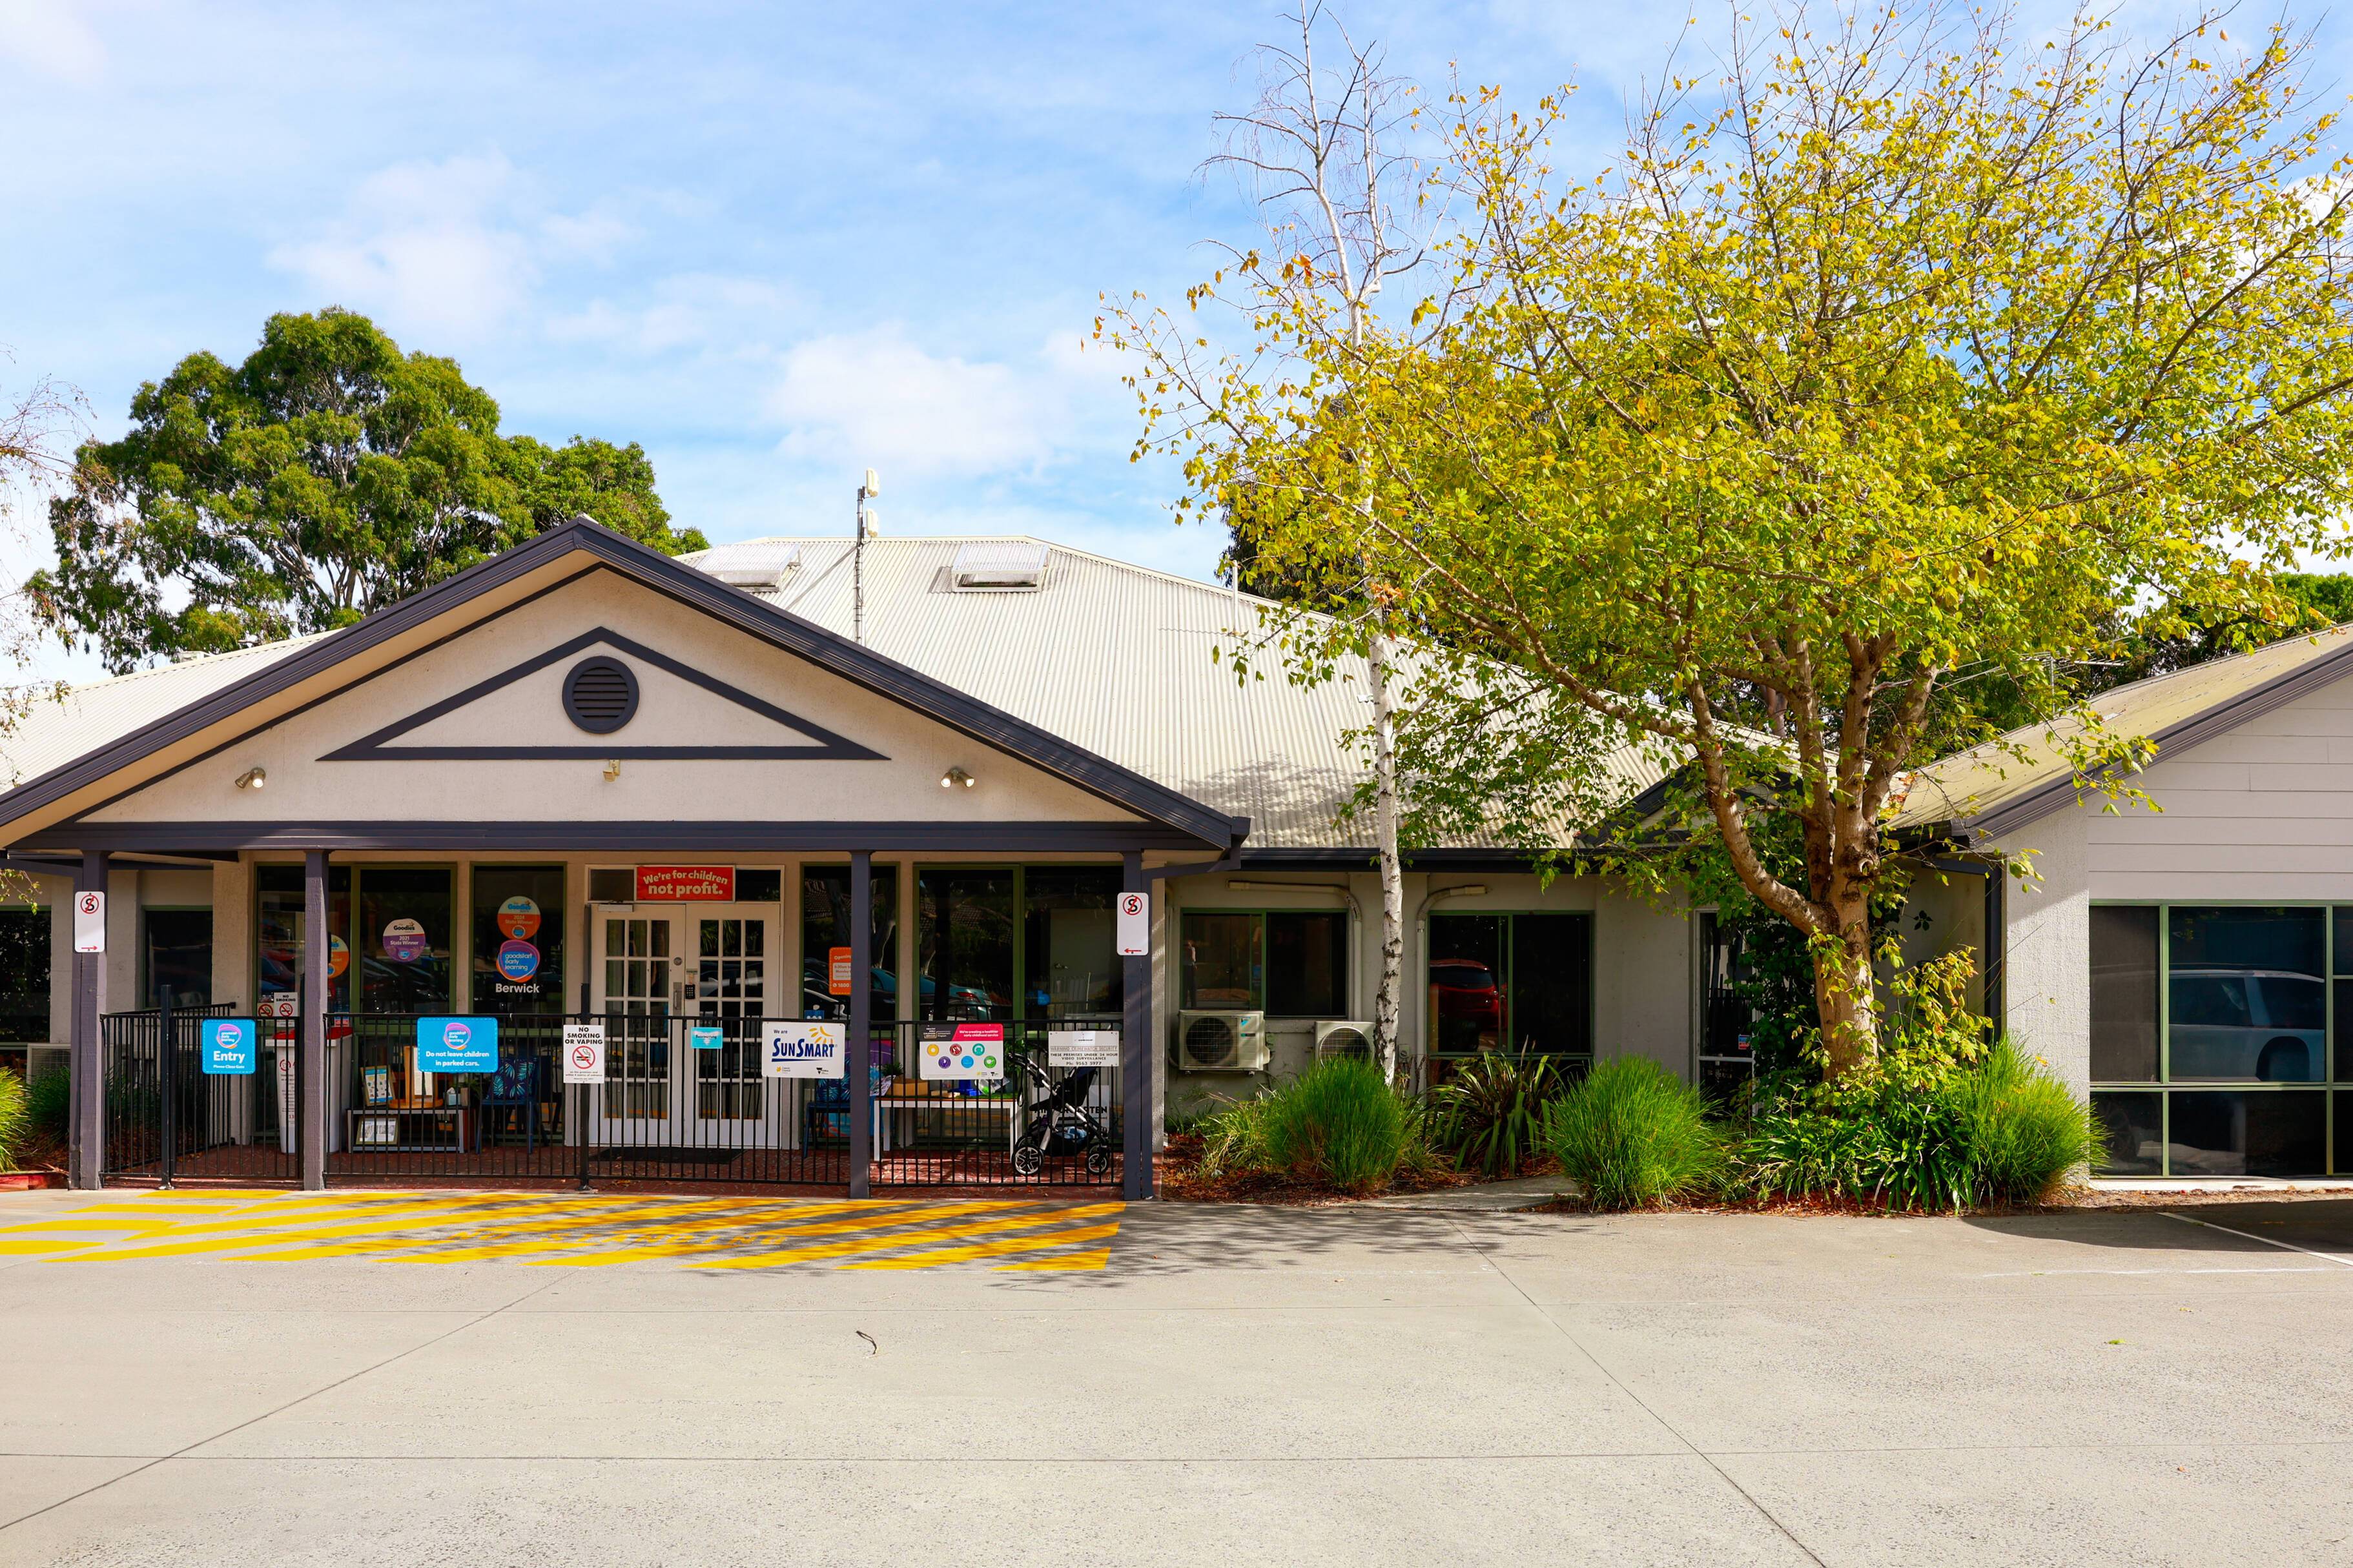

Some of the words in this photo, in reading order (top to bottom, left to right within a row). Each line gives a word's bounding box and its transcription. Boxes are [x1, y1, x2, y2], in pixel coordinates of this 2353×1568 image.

[643, 872, 671, 884] We're
[672, 870, 686, 879] for
[688, 870, 728, 884] children
[648, 883, 673, 894] not
[676, 881, 723, 897] profit.
[495, 983, 540, 993] Berwick
[213, 1050, 245, 1064] Entry
